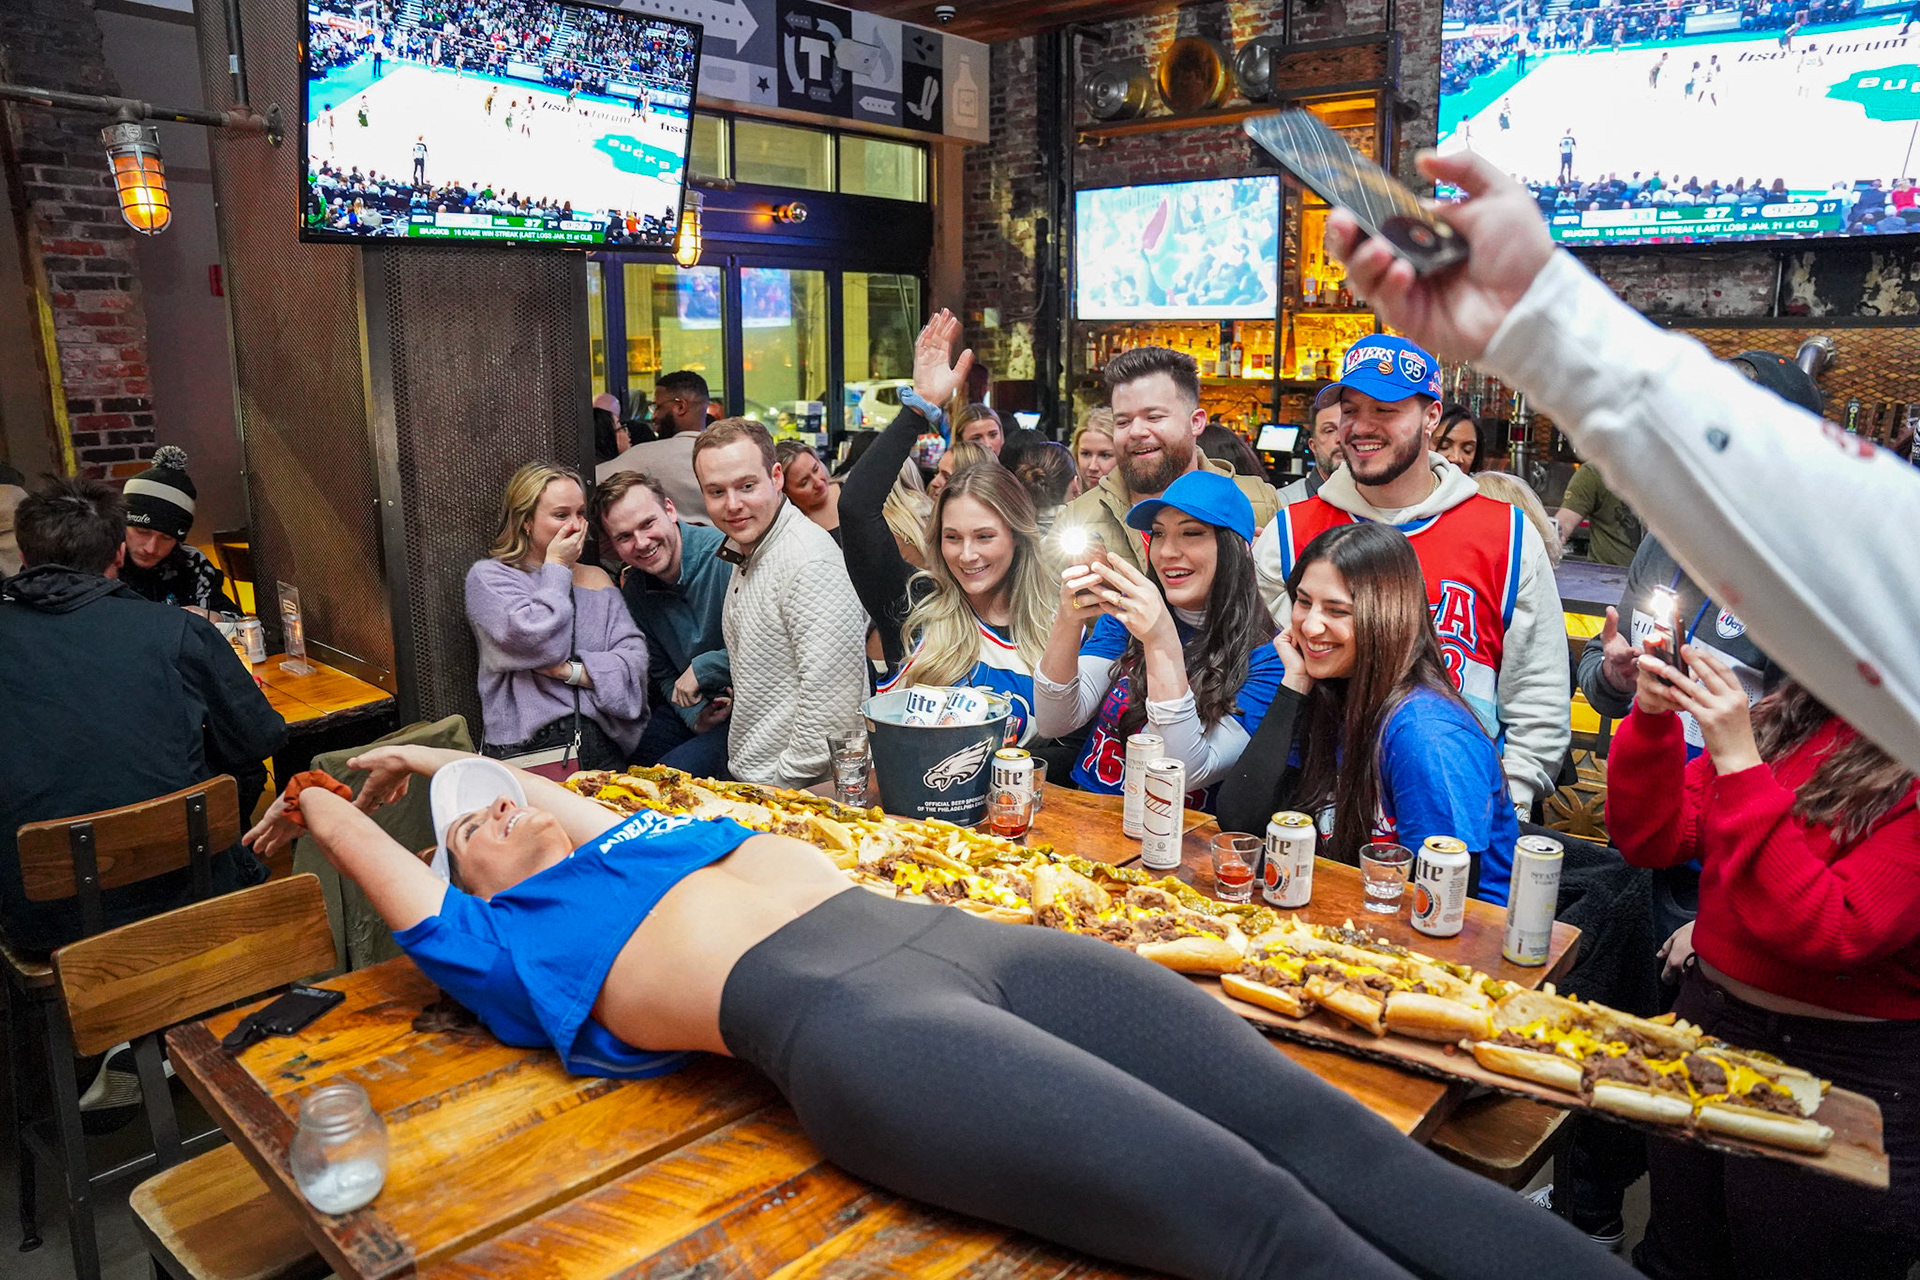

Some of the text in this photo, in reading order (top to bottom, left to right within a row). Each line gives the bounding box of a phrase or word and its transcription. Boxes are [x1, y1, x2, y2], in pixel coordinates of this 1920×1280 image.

[1826, 38, 1907, 55] forum
[800, 36, 830, 80] T
[592, 110, 631, 124] forum
[607, 138, 671, 170] BUCKS
[1704, 207, 1731, 219] 37
[1822, 203, 1836, 213] 17
[524, 218, 541, 228] 37
[594, 223, 602, 231] 17
[1615, 228, 1640, 236] GAME
[1641, 227, 1659, 235] WIN
[1660, 225, 1694, 234] STREAK
[1696, 224, 1722, 233] (LAST
[1723, 223, 1747, 232] LOSS
[1749, 222, 1769, 231] JAN.
[1772, 222, 1782, 230] 21
[1796, 220, 1819, 229] CLE)
[495, 231, 518, 239] STREAK
[519, 231, 535, 240] (LAST
[536, 232, 552, 240] LOSS
[1405, 361, 1422, 379] 95
[906, 691, 937, 713] Lite
[946, 692, 977, 713] Lite
[992, 765, 1023, 788] Lite
[937, 804, 975, 812] PHILADELPHIA
